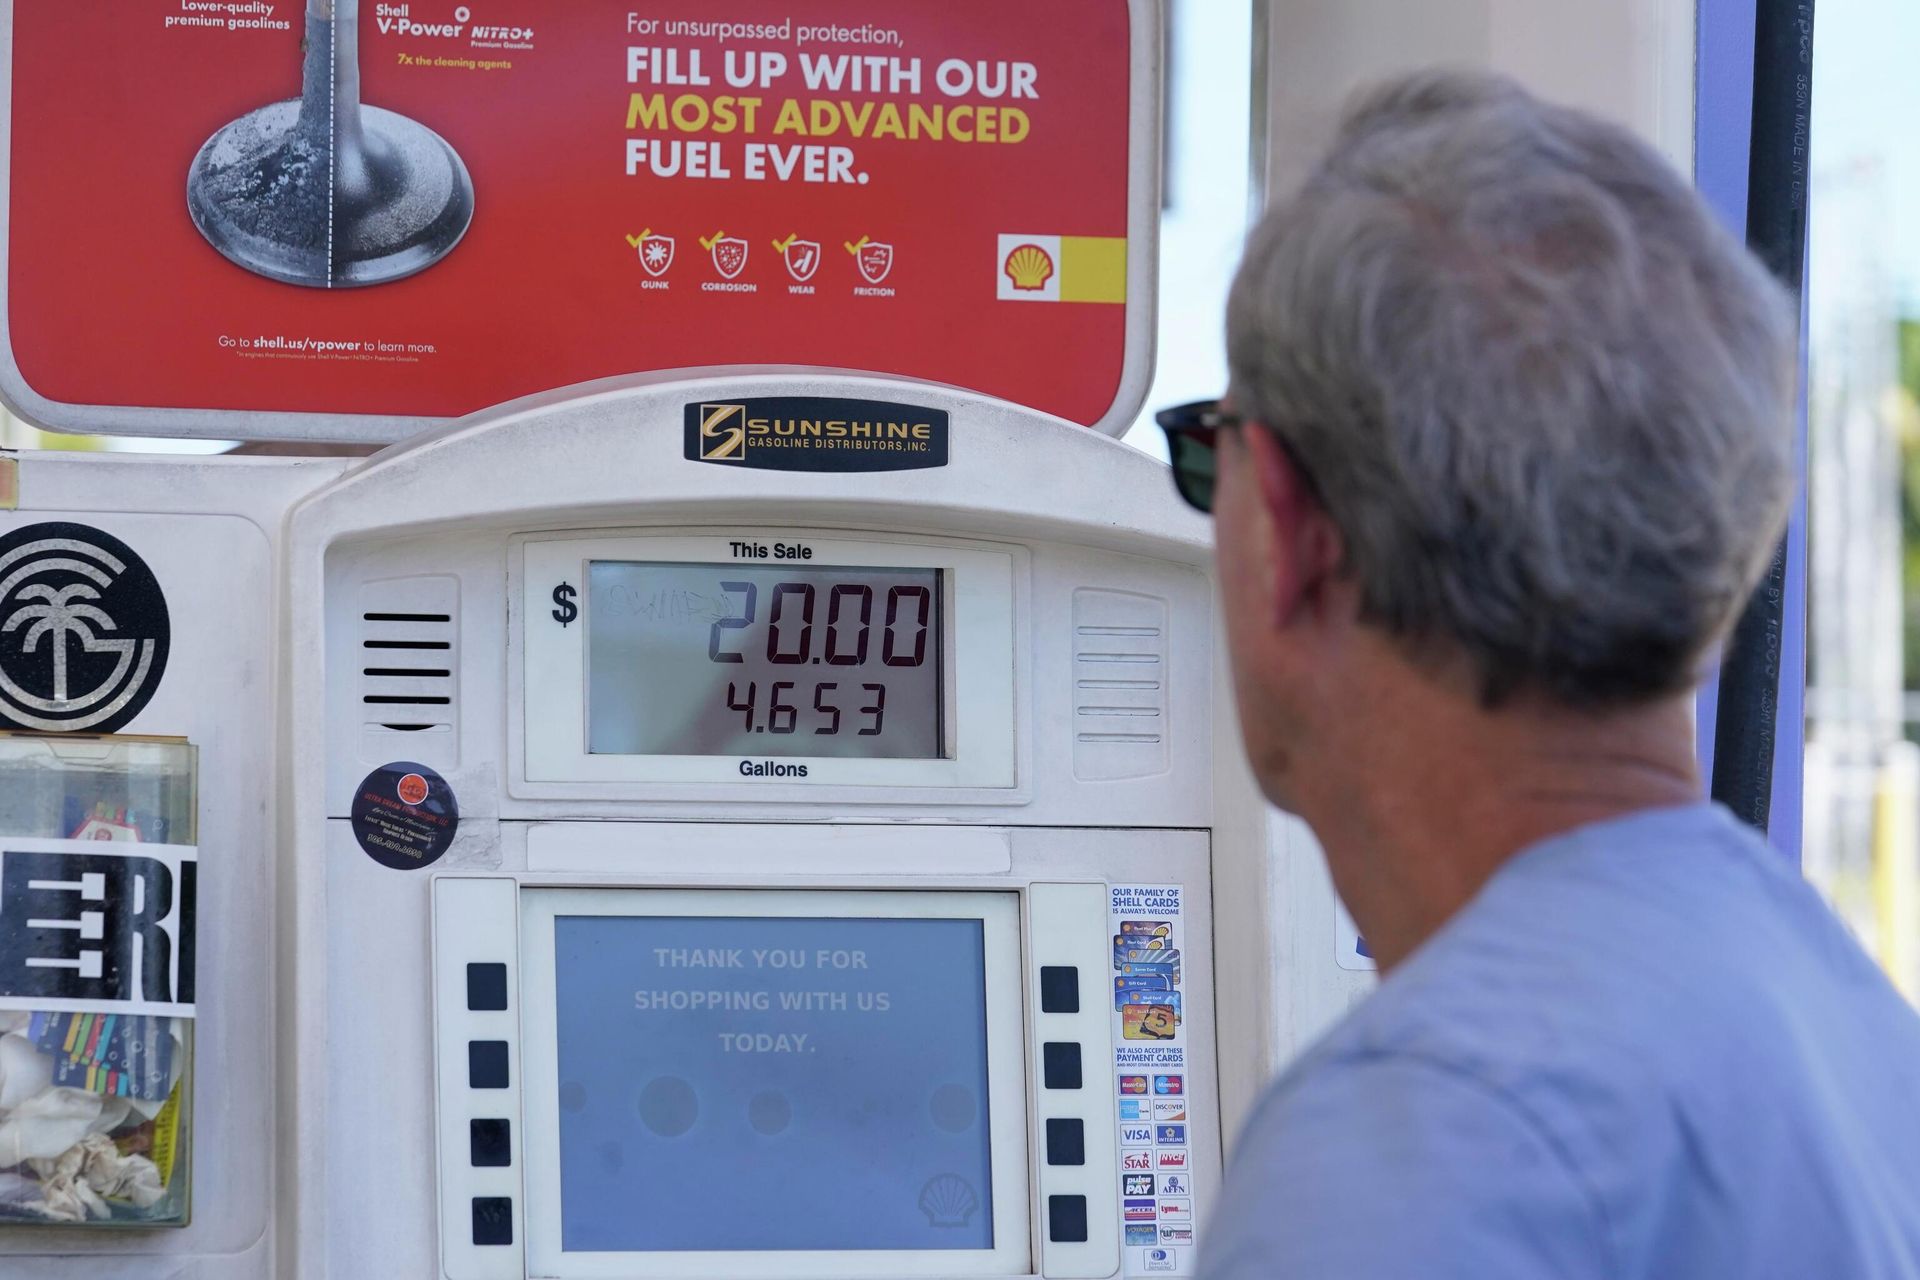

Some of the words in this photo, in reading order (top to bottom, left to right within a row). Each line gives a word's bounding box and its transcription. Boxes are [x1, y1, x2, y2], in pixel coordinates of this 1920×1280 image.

[181, 0, 274, 17] Lower-quality
[376, 4, 409, 17] Shell
[165, 14, 225, 27] premium
[228, 17, 290, 30] gasolines
[377, 17, 462, 38] V-Power
[627, 13, 659, 34] For
[665, 18, 790, 43] unsurpassed
[796, 24, 904, 48] protection,
[471, 40, 501, 48] Premium
[398, 53, 413, 65] 7x
[415, 55, 431, 66] the
[434, 57, 475, 70] cleaning
[477, 60, 512, 70] agents
[627, 47, 710, 86] FILL
[724, 50, 788, 89] UP
[799, 53, 922, 94] WITH
[936, 59, 1040, 99] OUR
[625, 93, 762, 134] MOST
[772, 99, 1031, 144] ADVANCED
[1794, 113, 1806, 156] MADE
[626, 139, 731, 180] FUEL
[745, 143, 870, 185] EVER.
[1792, 161, 1803, 176] IN
[641, 280, 669, 289] GUNK
[701, 282, 757, 292] CORROSION
[788, 285, 815, 294] WEAR
[854, 287, 895, 297] FRICTION
[218, 335, 236, 347] Go
[239, 336, 250, 347] to
[253, 337, 361, 351] shell.us/vpower
[364, 341, 375, 351] to
[377, 340, 405, 352] learn
[407, 344, 437, 353] more.
[747, 418, 931, 439] SUNSHINE
[748, 437, 810, 448] GASOLINE
[730, 542, 769, 559] This
[774, 543, 812, 560] Sale
[551, 581, 578, 628] $
[1768, 587, 1780, 608] BY
[708, 581, 930, 667] 20.00
[726, 681, 886, 736] 4.653
[739, 761, 808, 778] Gallons
[1112, 888, 1132, 896] OUR
[1134, 889, 1165, 897] FAMILY
[1167, 889, 1180, 897] OF
[1112, 897, 1142, 907] SHELL
[1144, 898, 1180, 907] CARDS
[654, 949, 744, 968] THANK
[752, 949, 806, 969] YOU
[816, 950, 869, 969] FOR
[634, 990, 770, 1010] SHOPPING
[779, 991, 848, 1011] WITH
[857, 992, 891, 1011] US
[1155, 1012, 1167, 1028] 5
[719, 1033, 816, 1053] TODAY.
[1117, 1054, 1154, 1062] PAYMENT
[1156, 1054, 1184, 1062] CARDS
[1124, 1129, 1151, 1140] VISA
[1124, 1159, 1150, 1169] STAR
[1125, 1184, 1152, 1195] PAY
